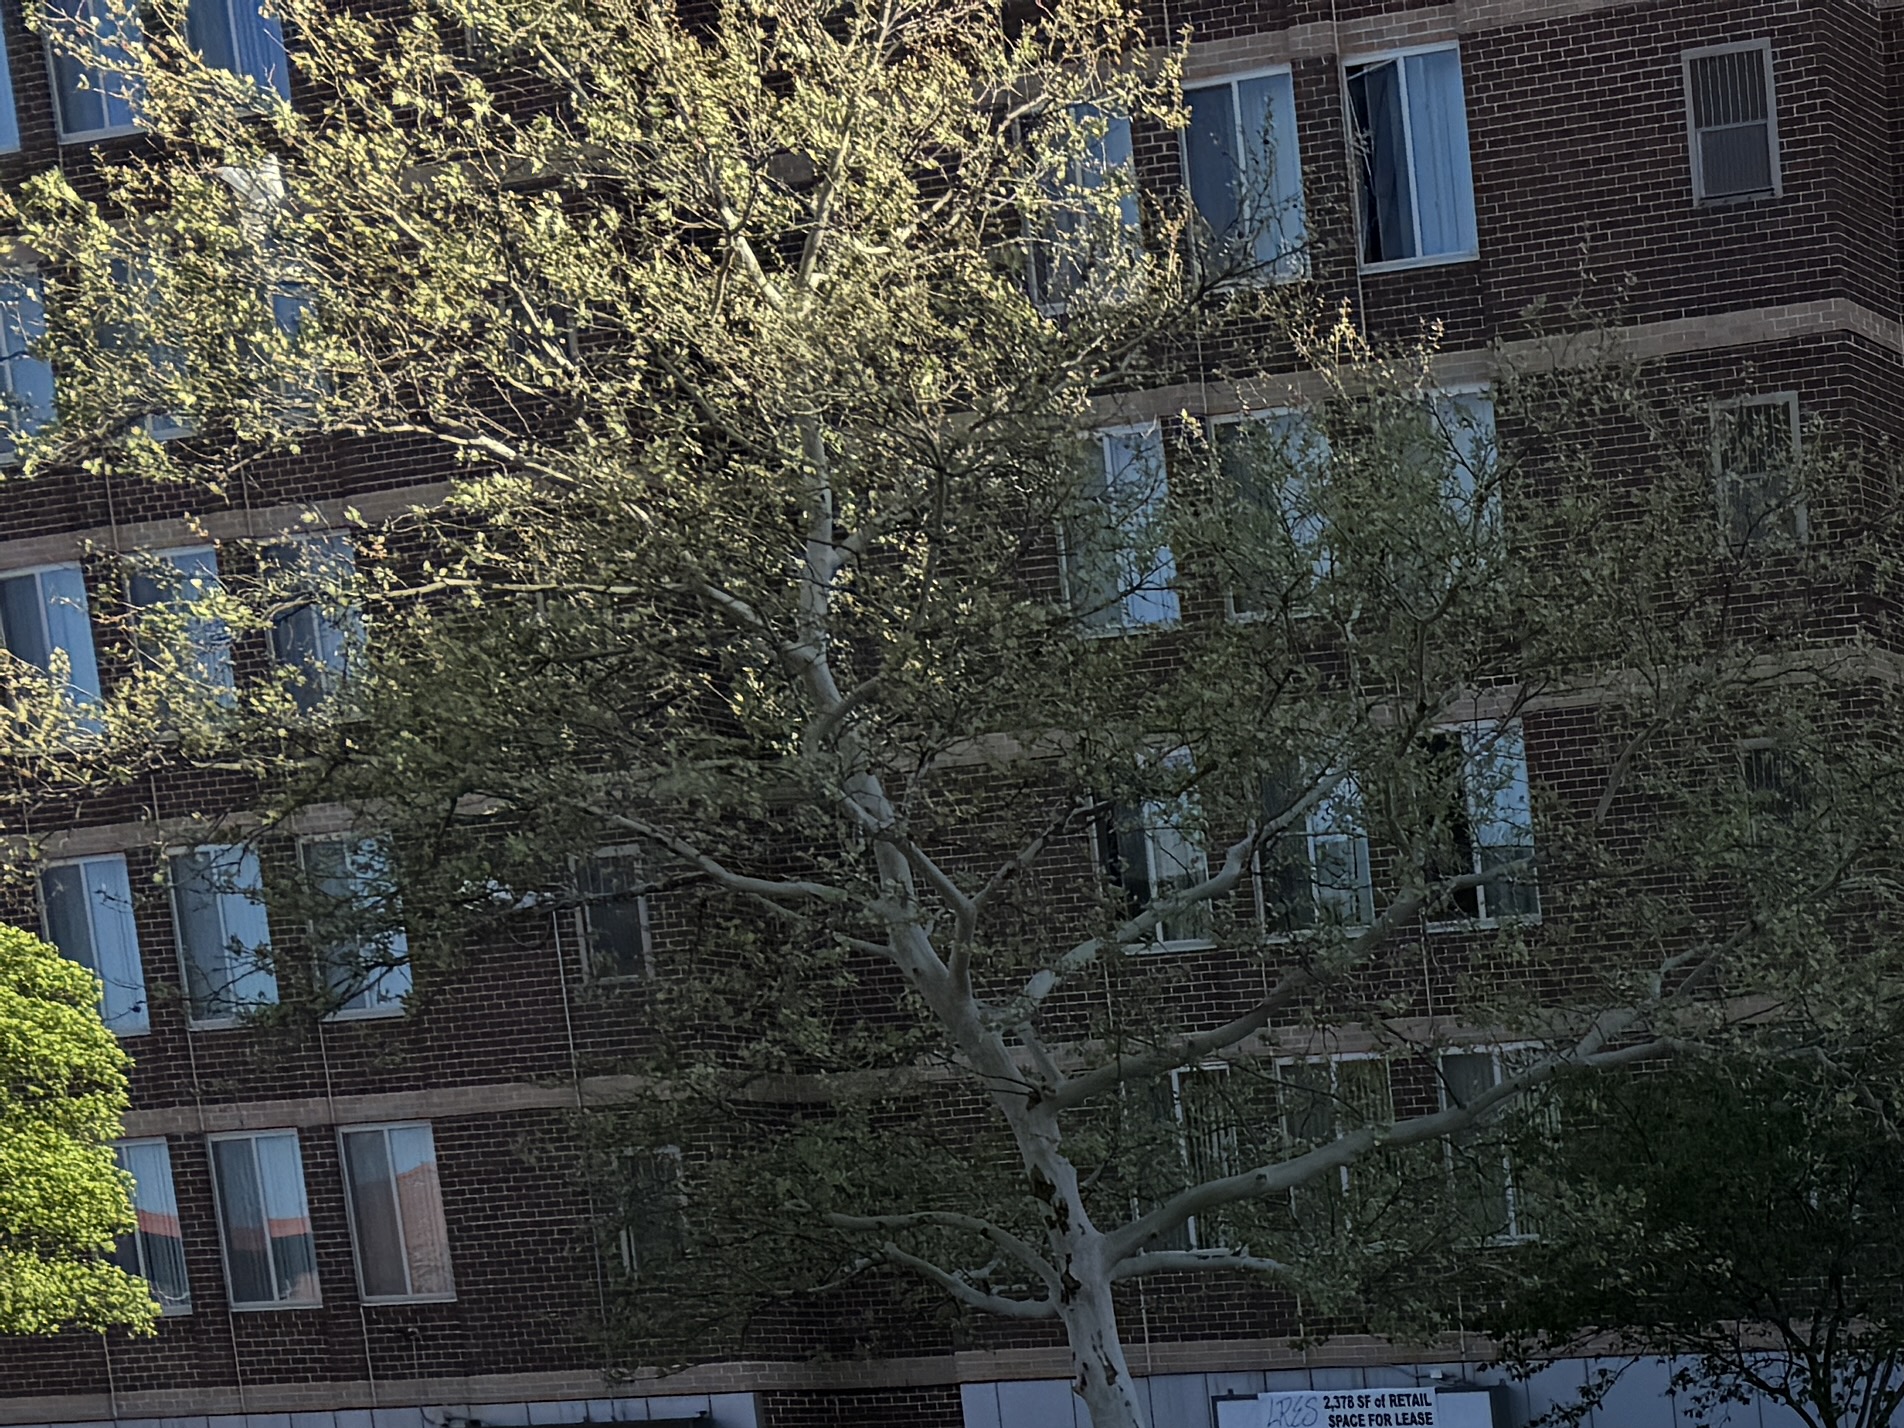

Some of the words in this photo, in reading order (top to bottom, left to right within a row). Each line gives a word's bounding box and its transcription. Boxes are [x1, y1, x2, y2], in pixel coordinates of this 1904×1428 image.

[1323, 1395, 1354, 1411] 2,378
[1357, 1395, 1371, 1409] SF
[1374, 1394, 1387, 1408] of
[1389, 1393, 1432, 1407] RETAIL
[1328, 1413, 1366, 1428] SPACE
[1368, 1413, 1392, 1427] FOR
[1395, 1412, 1433, 1426] LEASE
